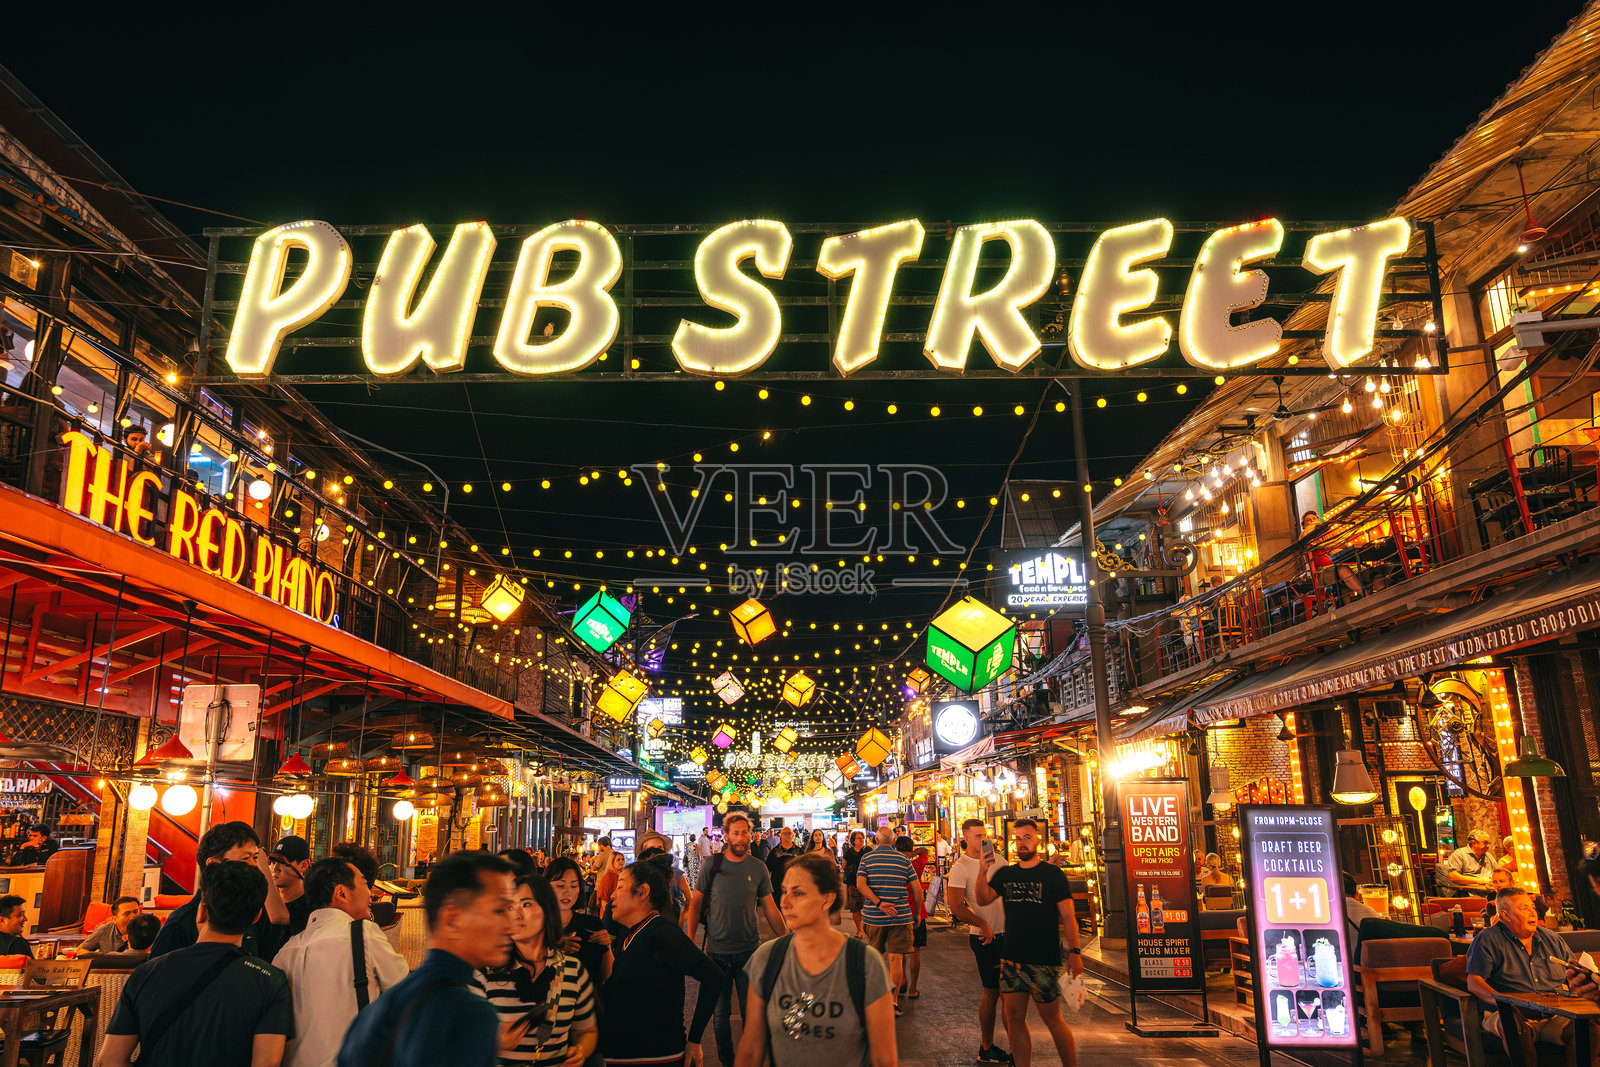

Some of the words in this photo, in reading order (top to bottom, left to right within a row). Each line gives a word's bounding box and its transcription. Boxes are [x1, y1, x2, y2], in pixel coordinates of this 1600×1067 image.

[225, 219, 624, 378] PUB
[671, 216, 1411, 377] STREET
[61, 431, 163, 547] THE
[169, 489, 246, 584] RED
[253, 534, 336, 625] PIANO
[1008, 552, 1087, 585] TEMPL
[1011, 595, 1023, 604] 20
[1398, 653, 1416, 673] THE
[1420, 646, 1446, 667] BEST
[1486, 623, 1525, 649] FIRED
[931, 645, 968, 676] TEMPLE
[15, 777, 52, 793] PIANO
[1129, 797, 1177, 816] LIVE
[1131, 816, 1178, 826] WESTERN
[1254, 816, 1275, 825] FROM
[1276, 816, 1323, 826] 10PM-CLOSE
[1132, 826, 1179, 842] BAND
[1133, 847, 1180, 857] UPSTAIRS
[1262, 841, 1293, 853] DRAFT
[1298, 841, 1322, 853] BEER
[1264, 859, 1324, 873] COCKTAILS
[1166, 911, 1187, 921] $1.00
[1138, 939, 1164, 947] HOUSE
[1166, 939, 1190, 947] SPIRIT
[1138, 947, 1161, 955] PLUS
[1164, 947, 1191, 955] MIXER
[65, 966, 82, 974] Piano
[778, 993, 844, 1019] GOD
